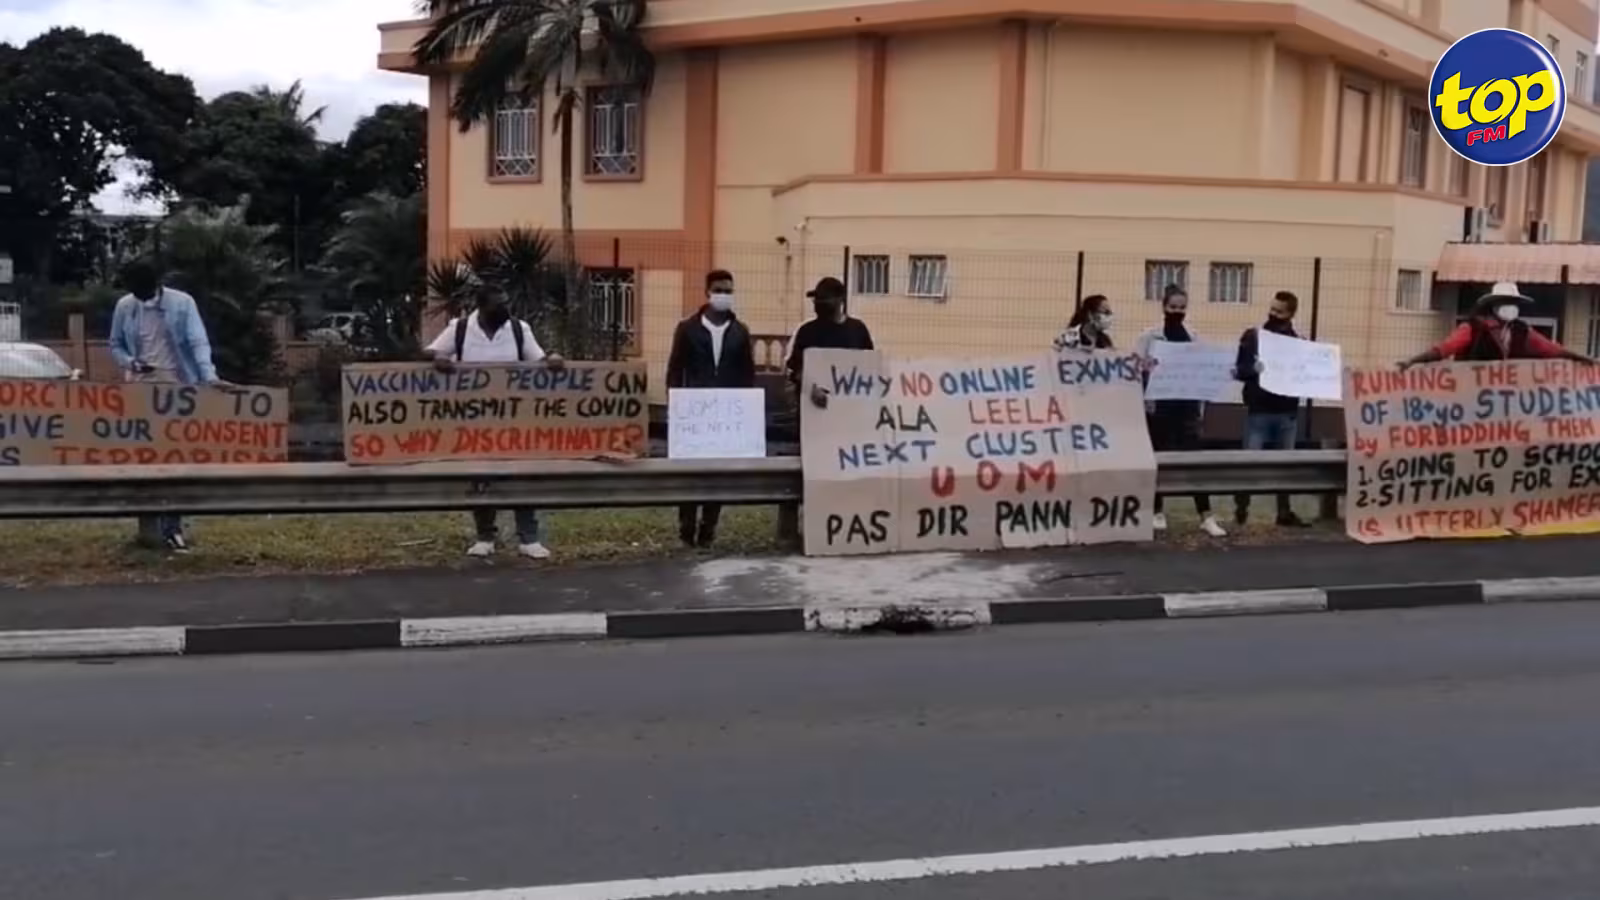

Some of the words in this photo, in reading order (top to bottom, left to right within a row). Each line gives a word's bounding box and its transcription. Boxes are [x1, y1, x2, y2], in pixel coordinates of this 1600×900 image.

[347, 368, 490, 395] VACCINATED
[506, 368, 594, 391] PEOPLE
[604, 370, 648, 395] CAN
[831, 366, 892, 397] WHY
[901, 372, 933, 397] NO
[939, 366, 1035, 395] ONLINE
[1353, 368, 1456, 399] RUINING
[1472, 365, 1518, 386] THE
[152, 386, 197, 416] US
[230, 389, 272, 417] TO
[348, 400, 408, 424] ALSO
[418, 398, 521, 420] TRANSMIT
[533, 399, 567, 418] THE
[576, 398, 642, 417] COVID
[876, 405, 937, 432] ALA
[969, 396, 1065, 424] LEELA
[1361, 401, 1388, 425] OF
[92, 417, 153, 442] OUR
[164, 419, 287, 447] CONSENT
[351, 434, 384, 457] SO
[395, 430, 440, 453] WHY
[450, 424, 644, 454] DISCRIMINATE?
[838, 440, 936, 469] NEXT
[966, 424, 1109, 458] CLUSTER
[1354, 430, 1377, 458] by
[1389, 420, 1530, 449] FORBIDDING
[1543, 416, 1596, 438] THEM
[1475, 447, 1508, 468] TO
[1511, 467, 1552, 493] FOR
[826, 511, 890, 545] PAS
[917, 504, 968, 537] DIR
[996, 499, 1071, 537] PANN
[1090, 496, 1140, 527] DIR
[1358, 517, 1384, 537] IS
